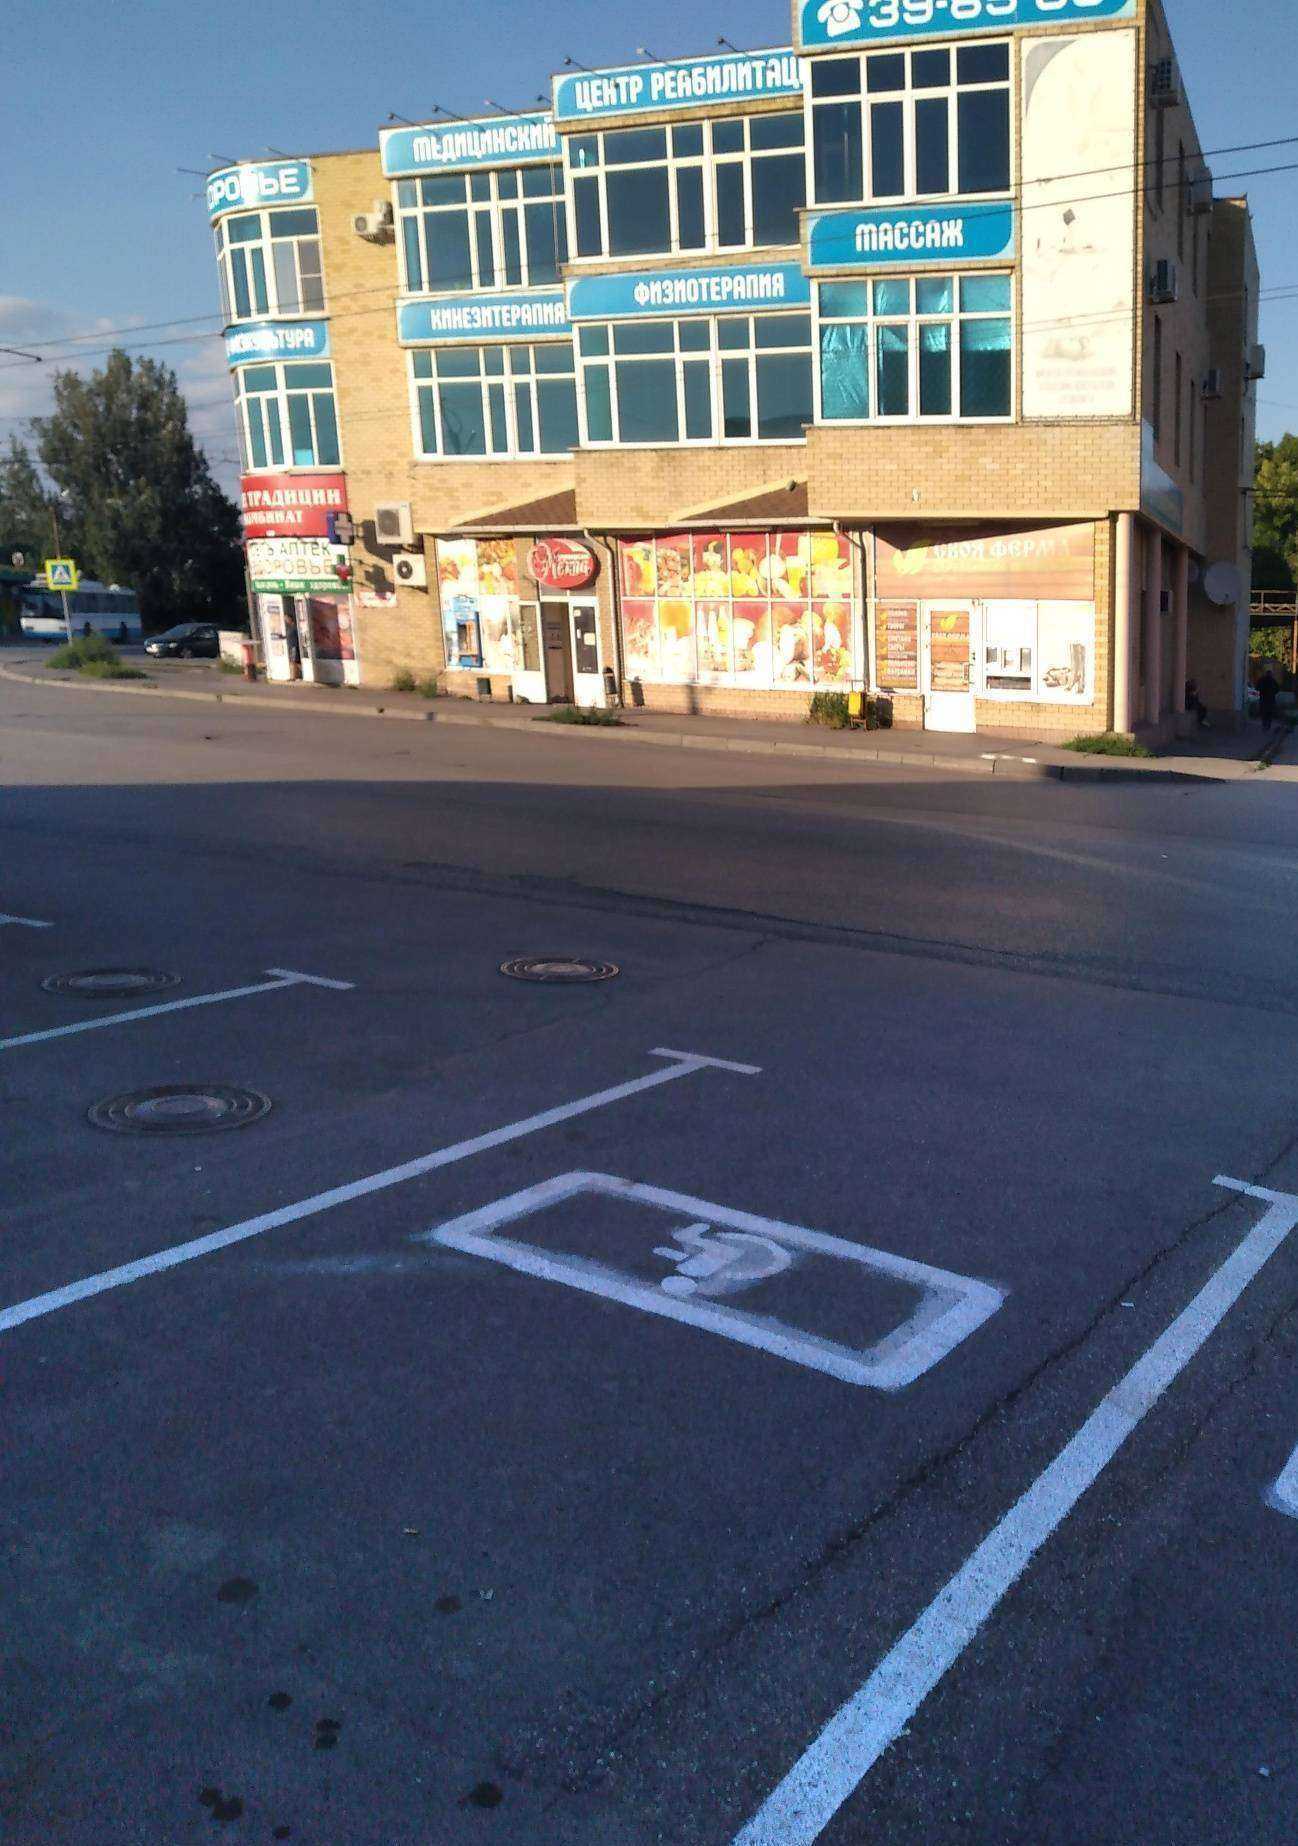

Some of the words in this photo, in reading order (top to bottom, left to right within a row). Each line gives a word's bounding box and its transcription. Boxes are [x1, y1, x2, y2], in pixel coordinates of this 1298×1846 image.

[575, 75, 643, 111] ЦЕНТР
[650, 56, 804, 101] РЕАБИЛИТАЦ
[412, 117, 556, 163] МЕДИЦИНСКИЙ
[855, 219, 964, 252] МАССАЖ
[633, 272, 785, 306] ФИЗИОТЕРАПИЯ
[430, 302, 566, 330] КИНЕЗИТЕРАПИЯ
